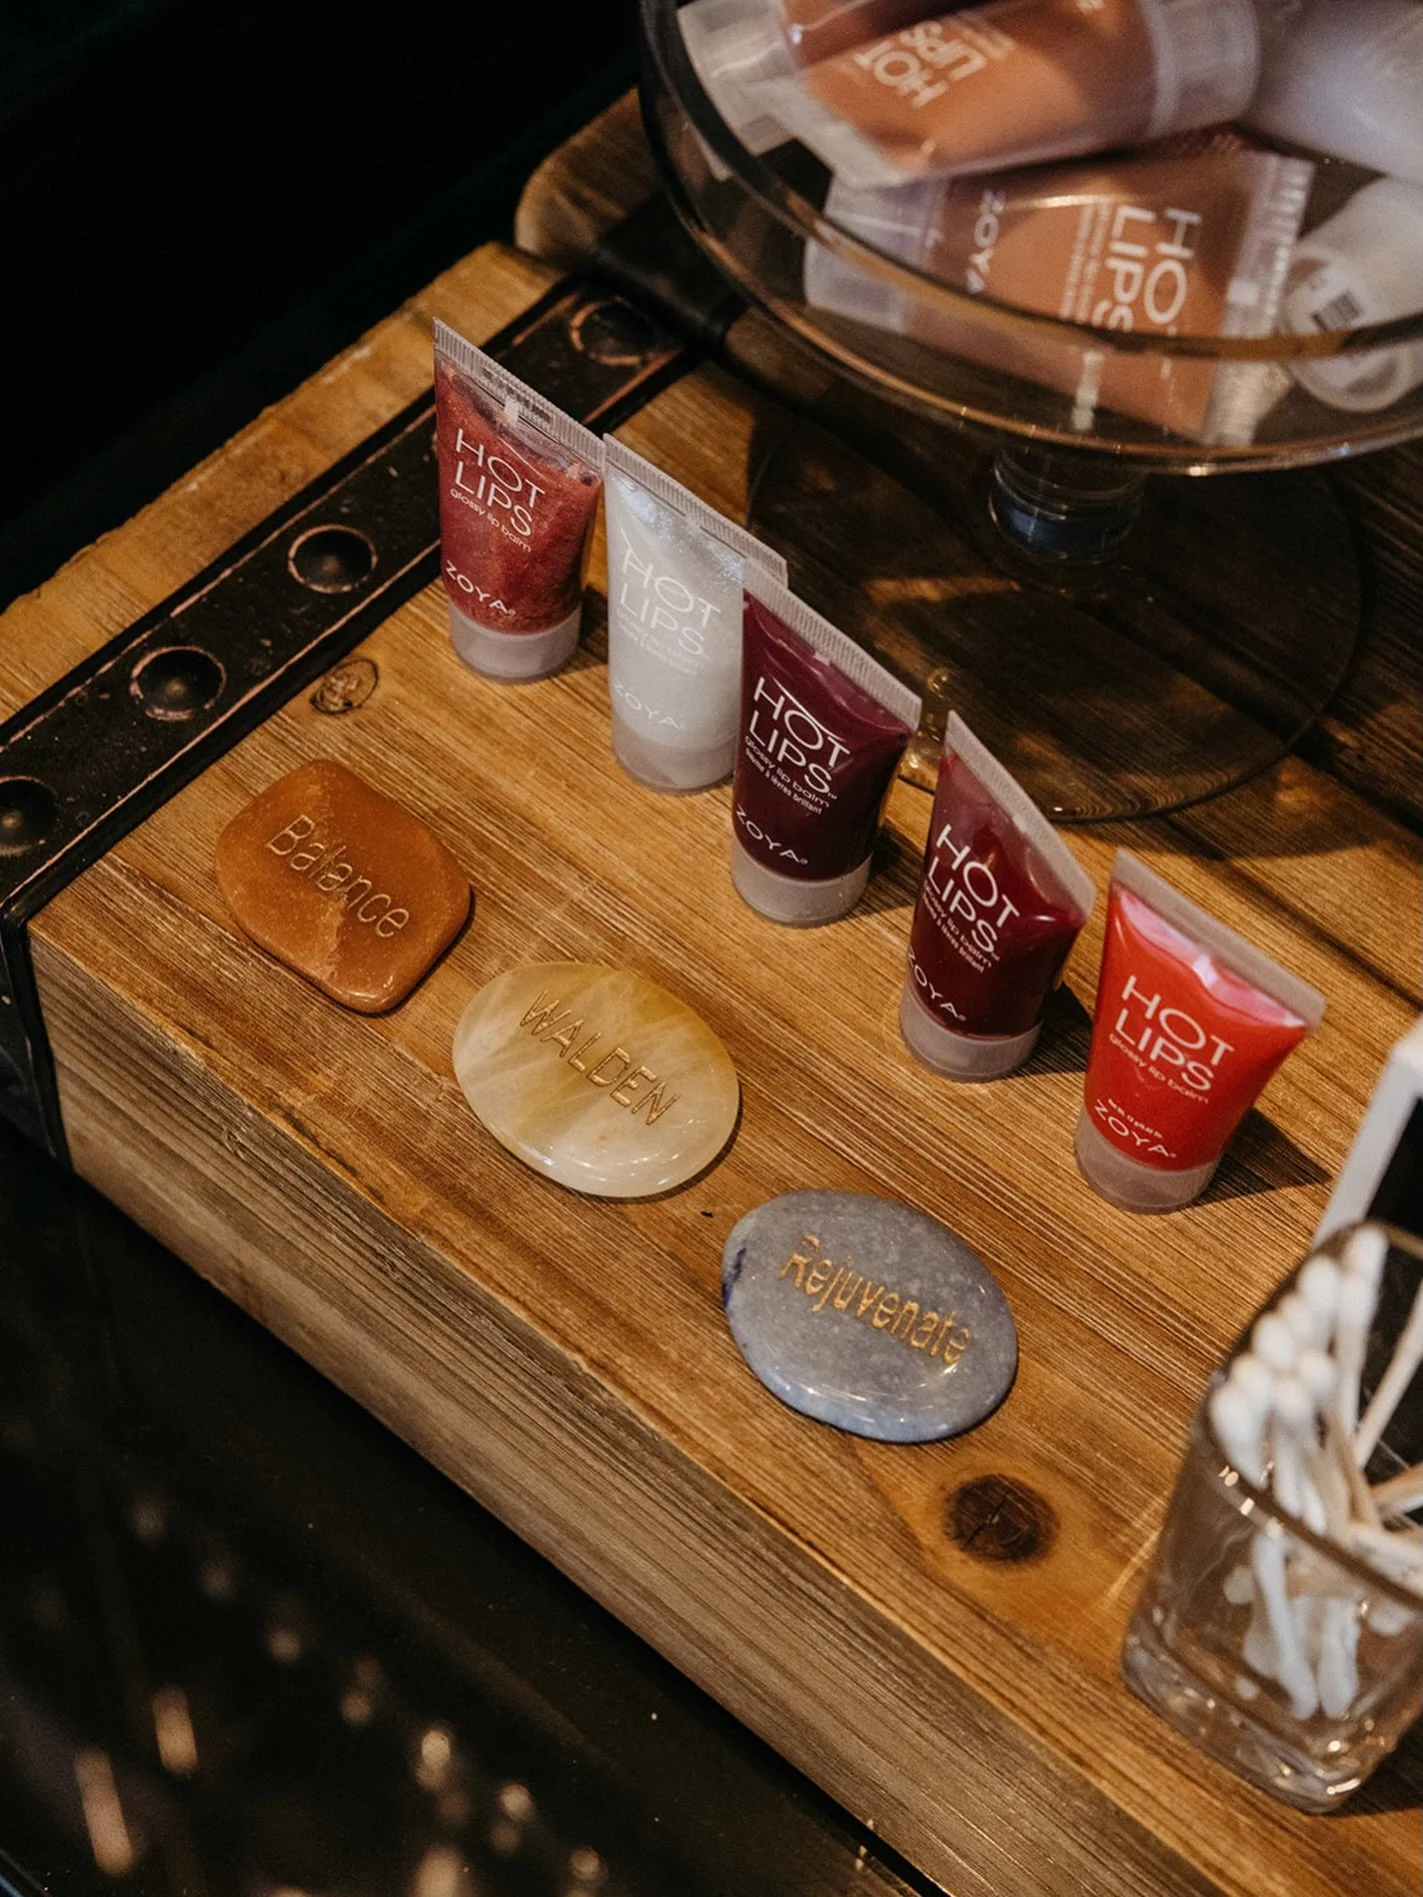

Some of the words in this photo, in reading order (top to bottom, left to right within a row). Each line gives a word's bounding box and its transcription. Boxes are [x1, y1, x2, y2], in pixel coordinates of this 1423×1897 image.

[1143, 207, 1202, 336] HO
[455, 428, 546, 509] HOT
[455, 461, 533, 537] LIPS
[487, 513, 501, 528] lip
[501, 526, 532, 552] balm
[620, 583, 705, 656] LIPS
[622, 549, 721, 628] HOT
[754, 677, 850, 768] HOT
[776, 768, 791, 784] lip
[792, 780, 830, 808] balm
[264, 814, 410, 938] Balance
[936, 824, 1020, 928] HOT
[519, 989, 682, 1126] WALDEN
[1115, 1008, 1214, 1091] LIPS
[1121, 975, 1235, 1066] HOT
[779, 1232, 971, 1365] Rejuvenate
